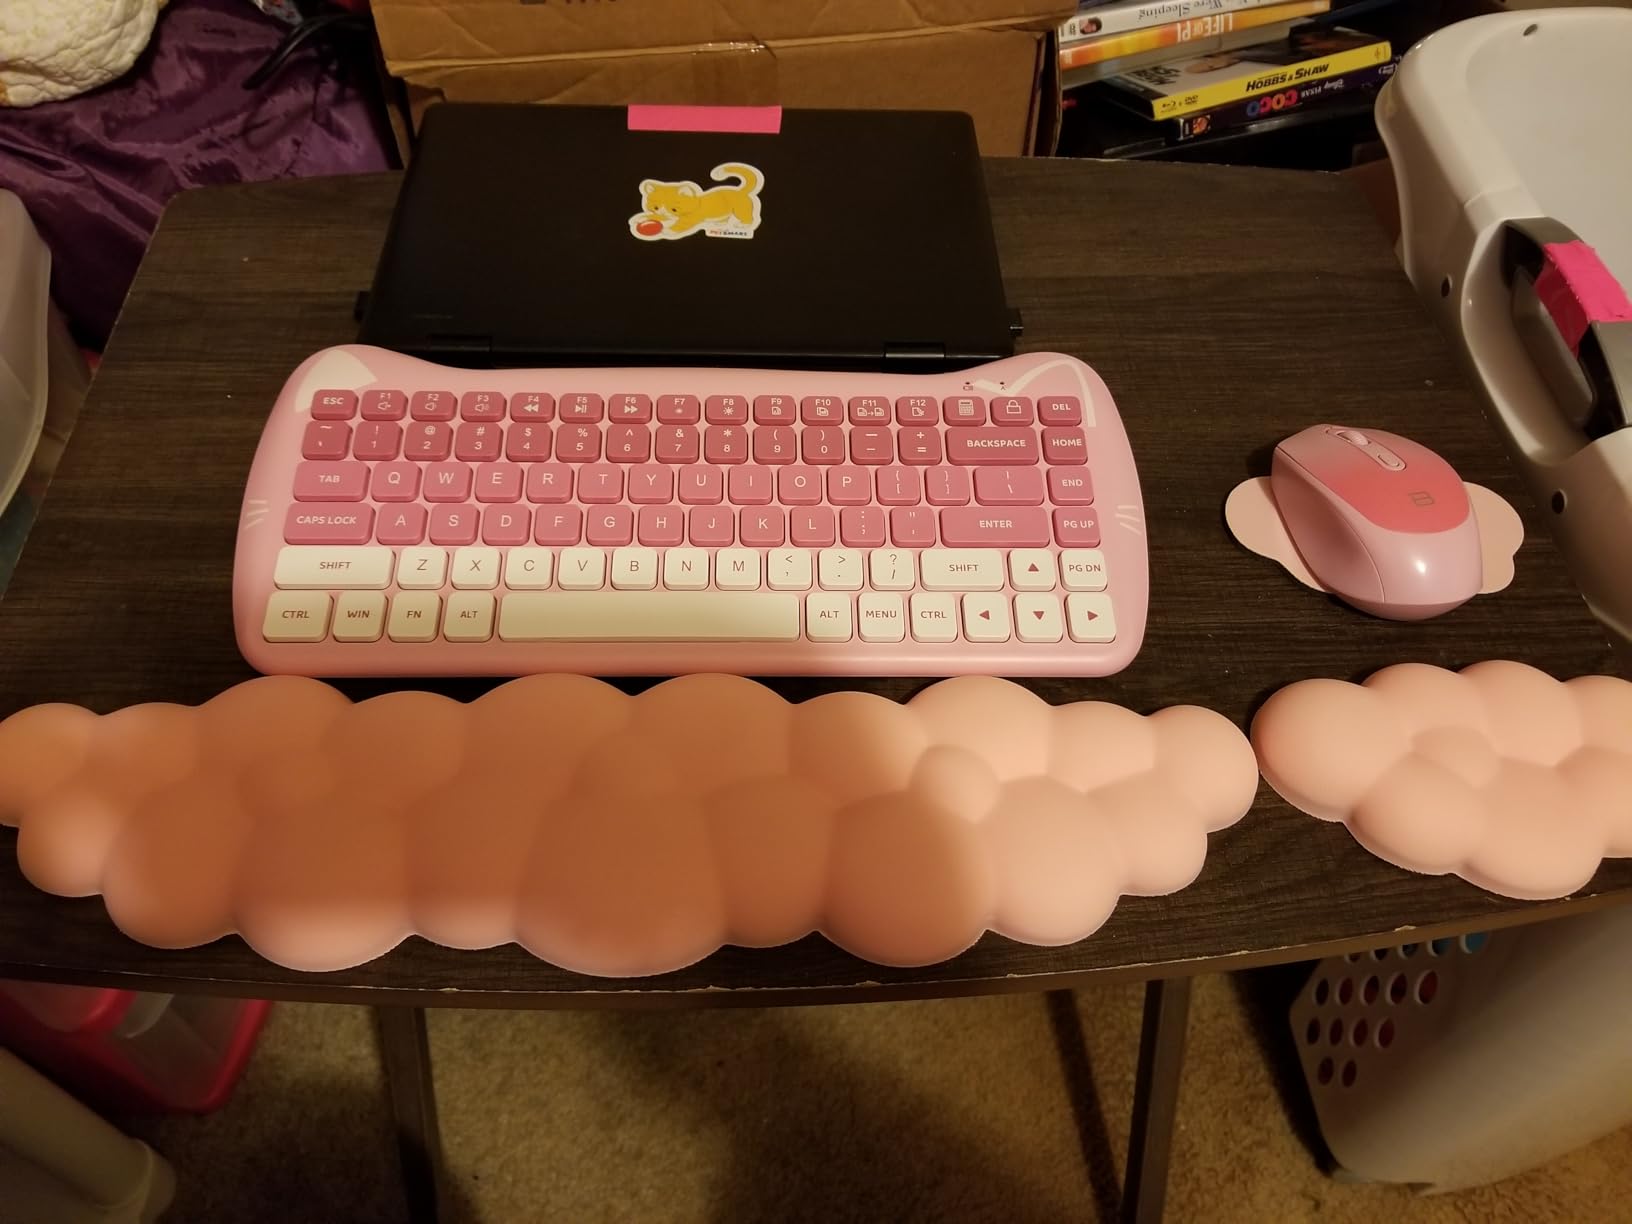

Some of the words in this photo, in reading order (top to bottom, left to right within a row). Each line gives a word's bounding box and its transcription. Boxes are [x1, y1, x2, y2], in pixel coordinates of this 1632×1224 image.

[1138, 4, 1190, 20] Sleeping
[1203, 12, 1233, 37] LIFE
[1176, 20, 1192, 43] PI
[1246, 74, 1287, 92] HOBBS
[1294, 63, 1329, 80] SHAW
[1246, 89, 1298, 117] COCO
[322, 396, 345, 405] ESC
[379, 392, 392, 400] F1
[427, 393, 440, 402] F2
[477, 394, 490, 402] F3
[527, 395, 540, 403] F4
[576, 396, 588, 404] F5
[624, 396, 637, 405] F6
[770, 397, 783, 405] F9
[674, 397, 686, 406] F7
[722, 398, 735, 406] F8
[815, 398, 832, 407] F10
[862, 399, 877, 407] F11
[909, 398, 926, 407] F12
[1052, 403, 1071, 411] DEL
[424, 425, 436, 436] @
[476, 426, 485, 436] #
[524, 427, 532, 437] $
[577, 427, 589, 438] %
[675, 428, 684, 438] &
[773, 428, 778, 441] (
[820, 429, 825, 441] )
[916, 431, 925, 439] +
[423, 440, 432, 450] 2
[474, 441, 483, 450] 3
[522, 441, 531, 450] 4
[575, 442, 584, 452] 5
[623, 443, 631, 452] 6
[674, 443, 682, 452] 7
[966, 439, 1027, 448] BACKSPACE
[1052, 438, 1083, 447] HOME
[723, 443, 731, 453] 8
[773, 444, 781, 453] 9
[319, 474, 341, 483] TAB
[387, 471, 401, 485] Q
[438, 471, 455, 485] W
[491, 471, 503, 485] E
[542, 472, 554, 485] R
[598, 473, 609, 485] T
[646, 473, 657, 486] Y
[696, 473, 707, 487] U
[842, 476, 852, 488] P
[1061, 478, 1083, 487] END
[1007, 483, 1013, 494] \
[296, 515, 326, 525] CAPS
[327, 515, 357, 525] LOCK
[394, 514, 406, 527] A
[448, 514, 459, 527] S
[500, 514, 512, 528] D
[554, 515, 564, 527] F
[603, 516, 616, 528] G
[656, 516, 667, 529] H
[707, 517, 716, 529] J
[758, 517, 768, 529] K
[808, 518, 817, 530] L
[979, 519, 1013, 529] ENTER
[1063, 519, 1078, 529] PG
[1079, 519, 1095, 529] UP
[785, 554, 793, 564] <
[837, 555, 846, 564] >
[889, 553, 898, 566] ?
[319, 561, 352, 570] SHIFT
[416, 558, 428, 571] Z
[469, 559, 482, 572] X
[523, 559, 535, 572] C
[577, 559, 589, 572] V
[629, 560, 640, 572] B
[681, 560, 692, 572] N
[732, 560, 745, 572] M
[948, 564, 979, 572] SHIFT
[1068, 564, 1083, 573] PG
[1085, 564, 1101, 573] DN
[891, 568, 896, 580] /
[281, 610, 310, 619] CTRL
[347, 609, 370, 619] WIN
[406, 610, 422, 619] FN
[459, 610, 478, 619] ALT
[819, 610, 840, 619] ALT
[865, 610, 897, 619] MENU
[920, 610, 947, 619] CTRL
